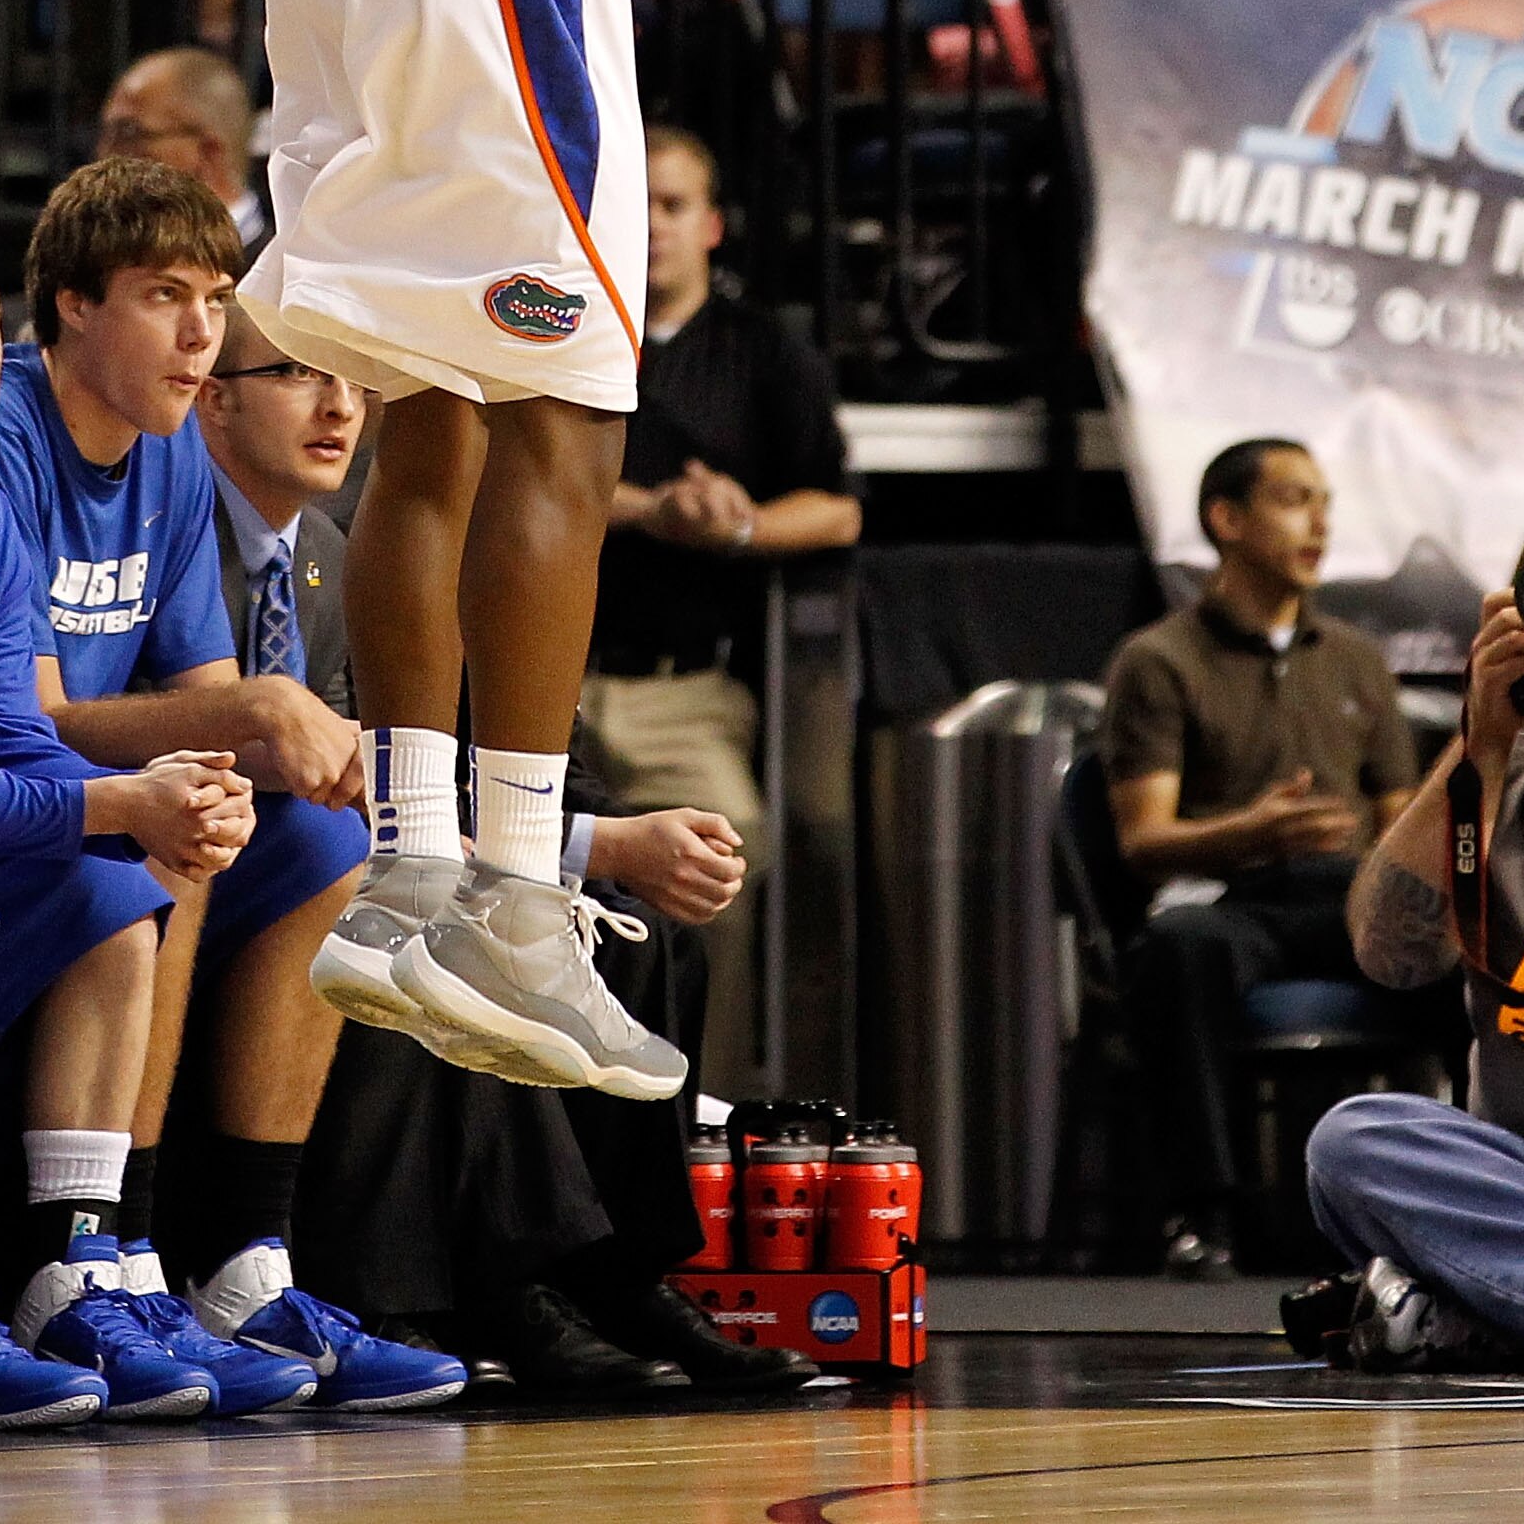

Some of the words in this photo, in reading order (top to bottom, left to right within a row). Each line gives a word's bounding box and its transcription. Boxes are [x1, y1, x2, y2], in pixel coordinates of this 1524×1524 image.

[1176, 150, 1480, 266] MARCH
[1457, 822, 1476, 875] EOS
[811, 1315, 860, 1332] NCAA
